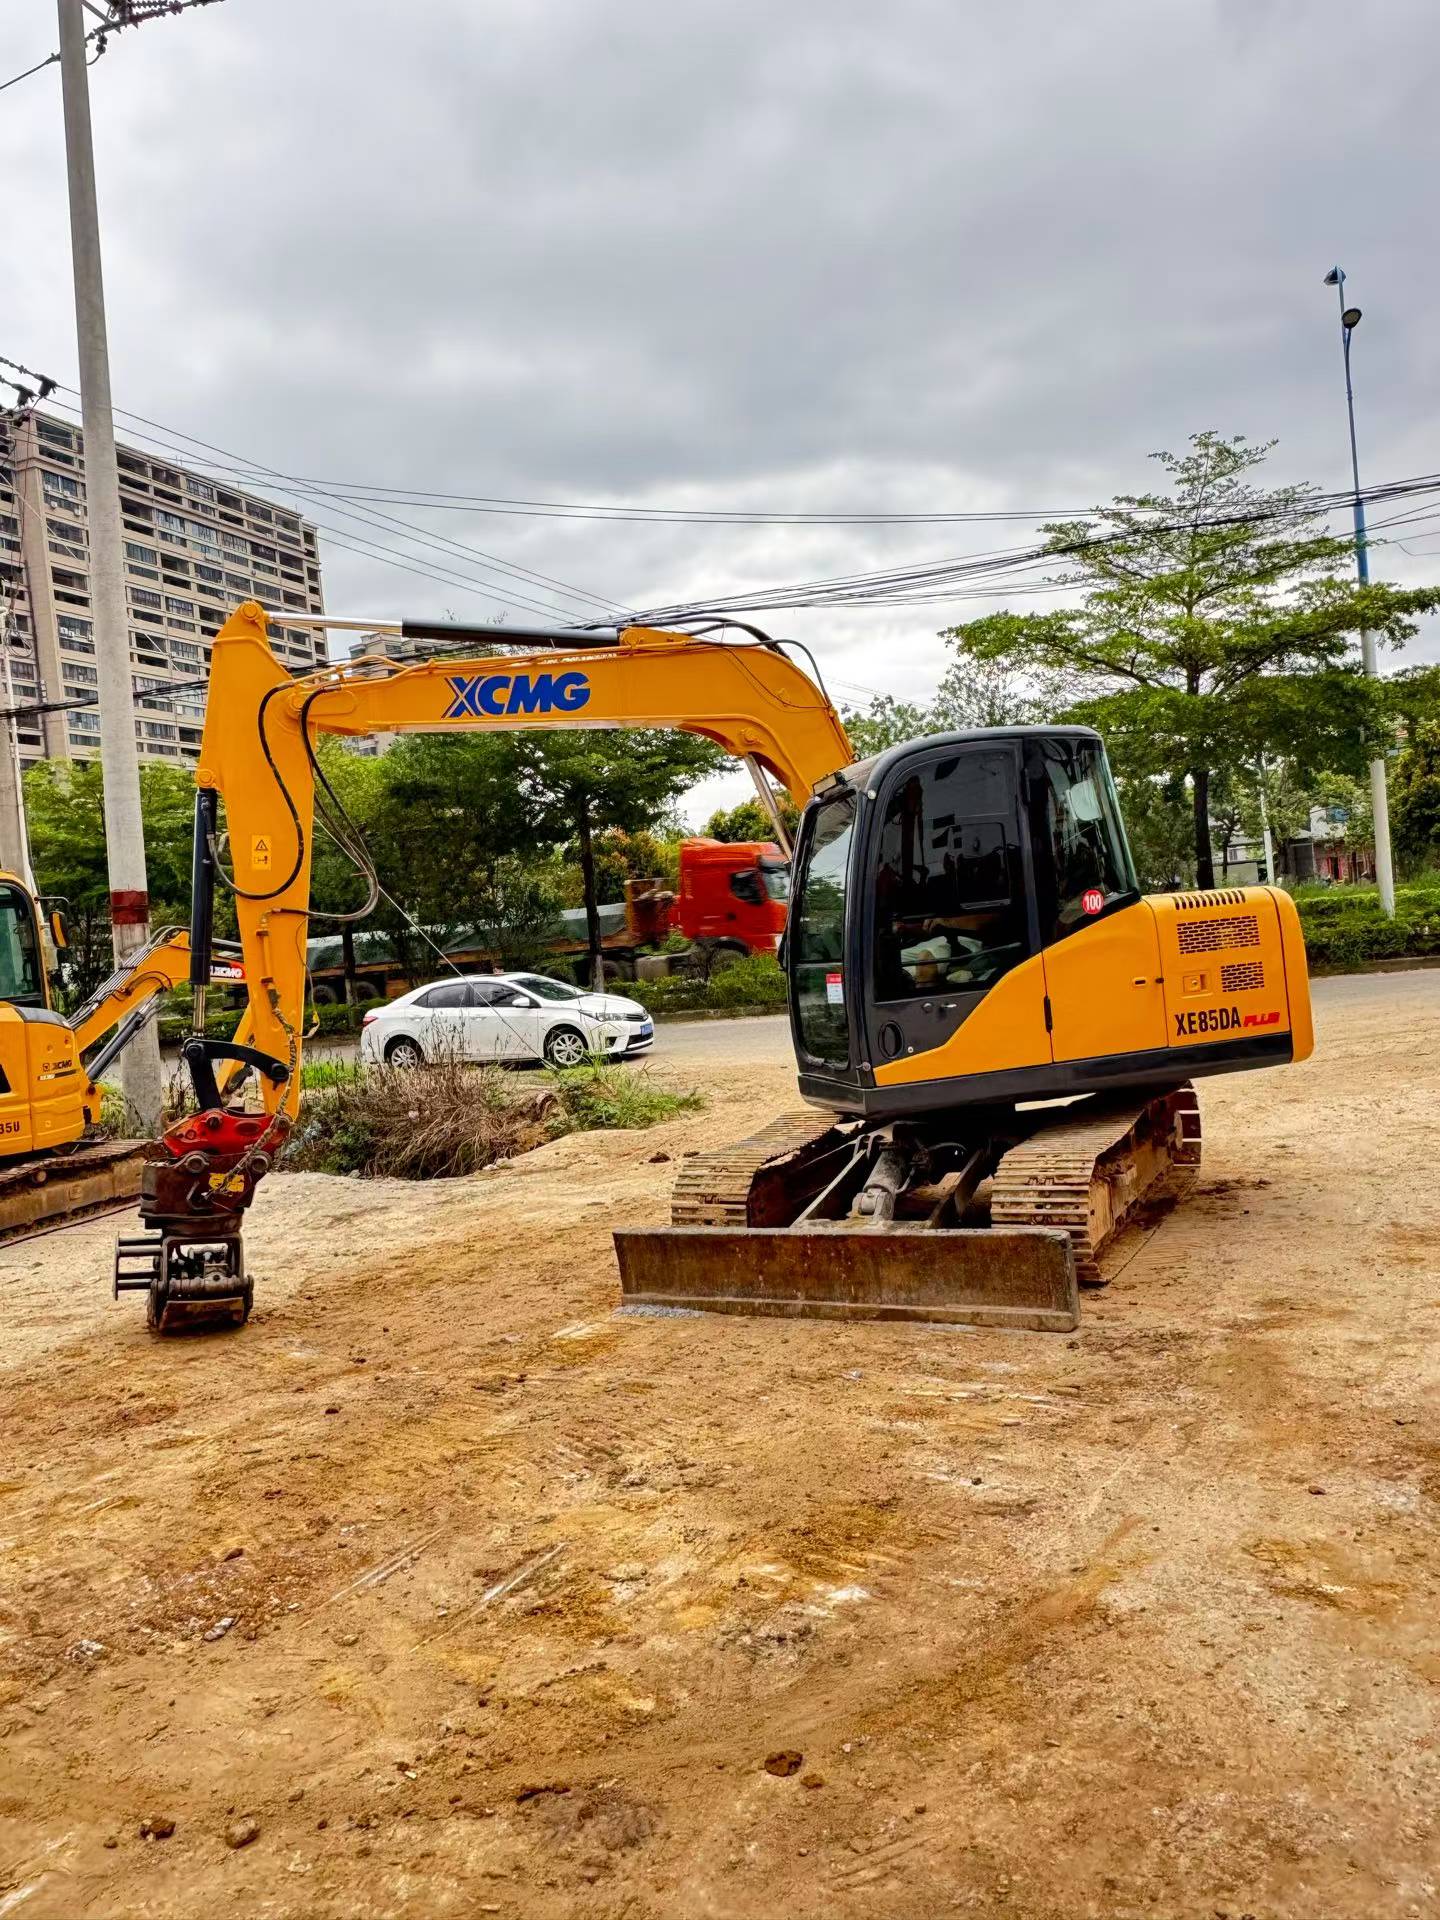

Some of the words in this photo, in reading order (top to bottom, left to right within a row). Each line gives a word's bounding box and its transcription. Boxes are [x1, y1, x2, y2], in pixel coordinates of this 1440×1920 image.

[441, 672, 591, 719] XCMG
[1085, 894, 1102, 911] 100
[1175, 1006, 1241, 1036] XE85DA
[1243, 1011, 1281, 1028] PLUS
